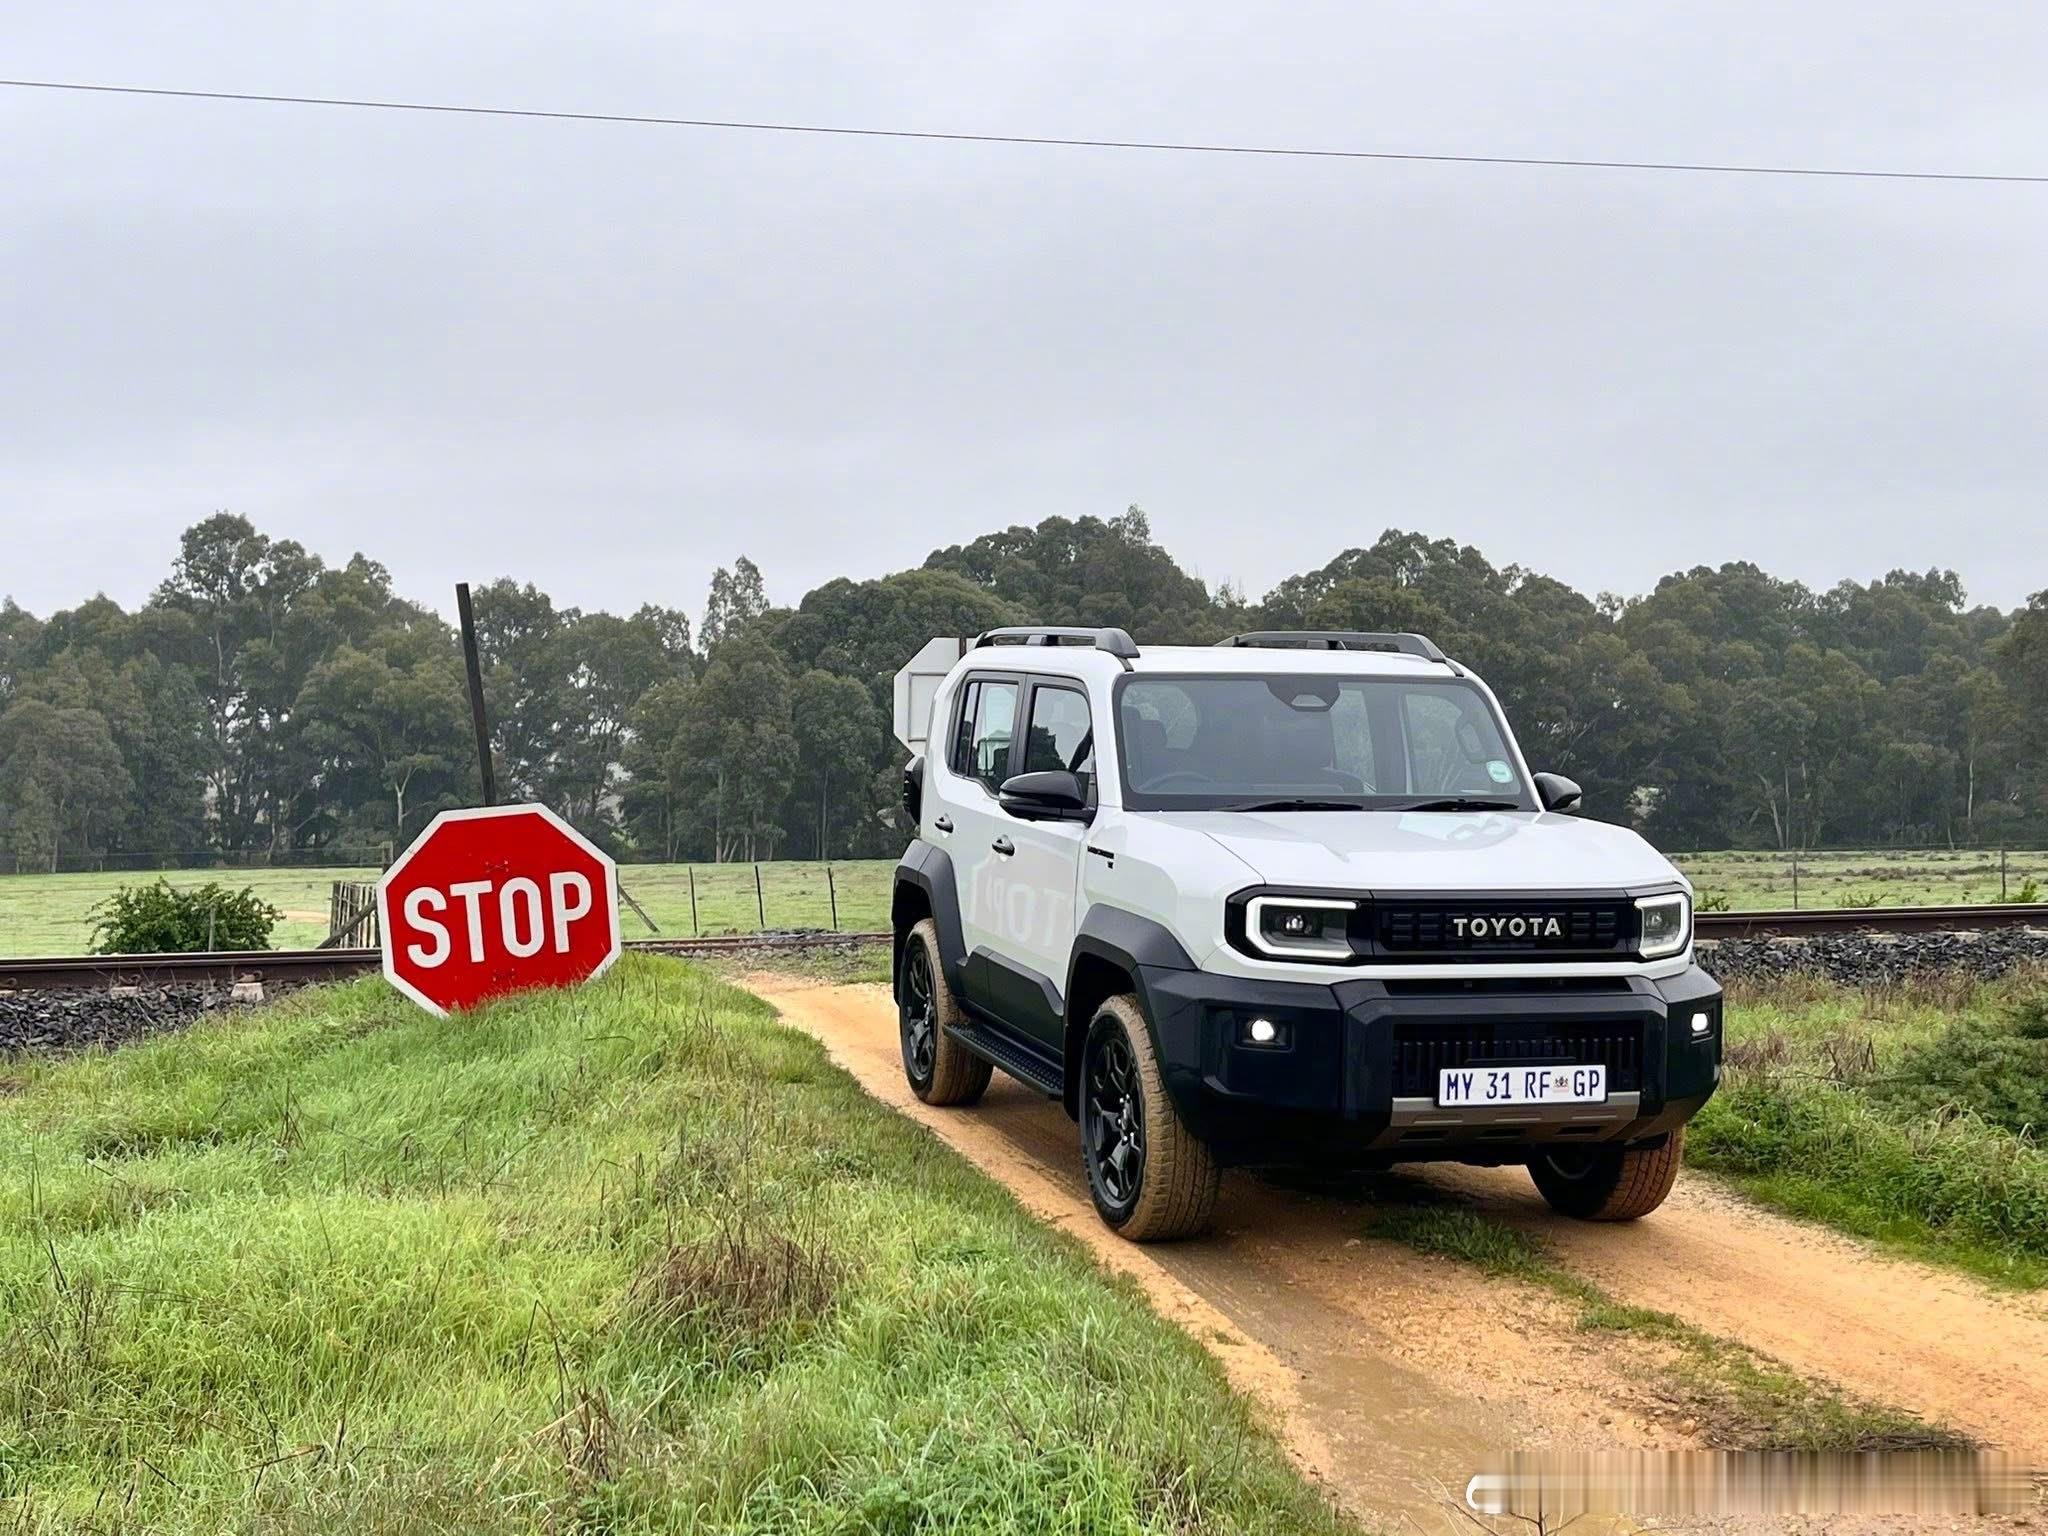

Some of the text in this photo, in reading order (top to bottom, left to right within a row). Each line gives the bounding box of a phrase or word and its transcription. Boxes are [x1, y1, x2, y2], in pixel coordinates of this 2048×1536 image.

[404, 871, 592, 968] STOP
[1453, 917, 1561, 937] TOYOTA
[1446, 1069, 1600, 1100] MY 31 RF GP
